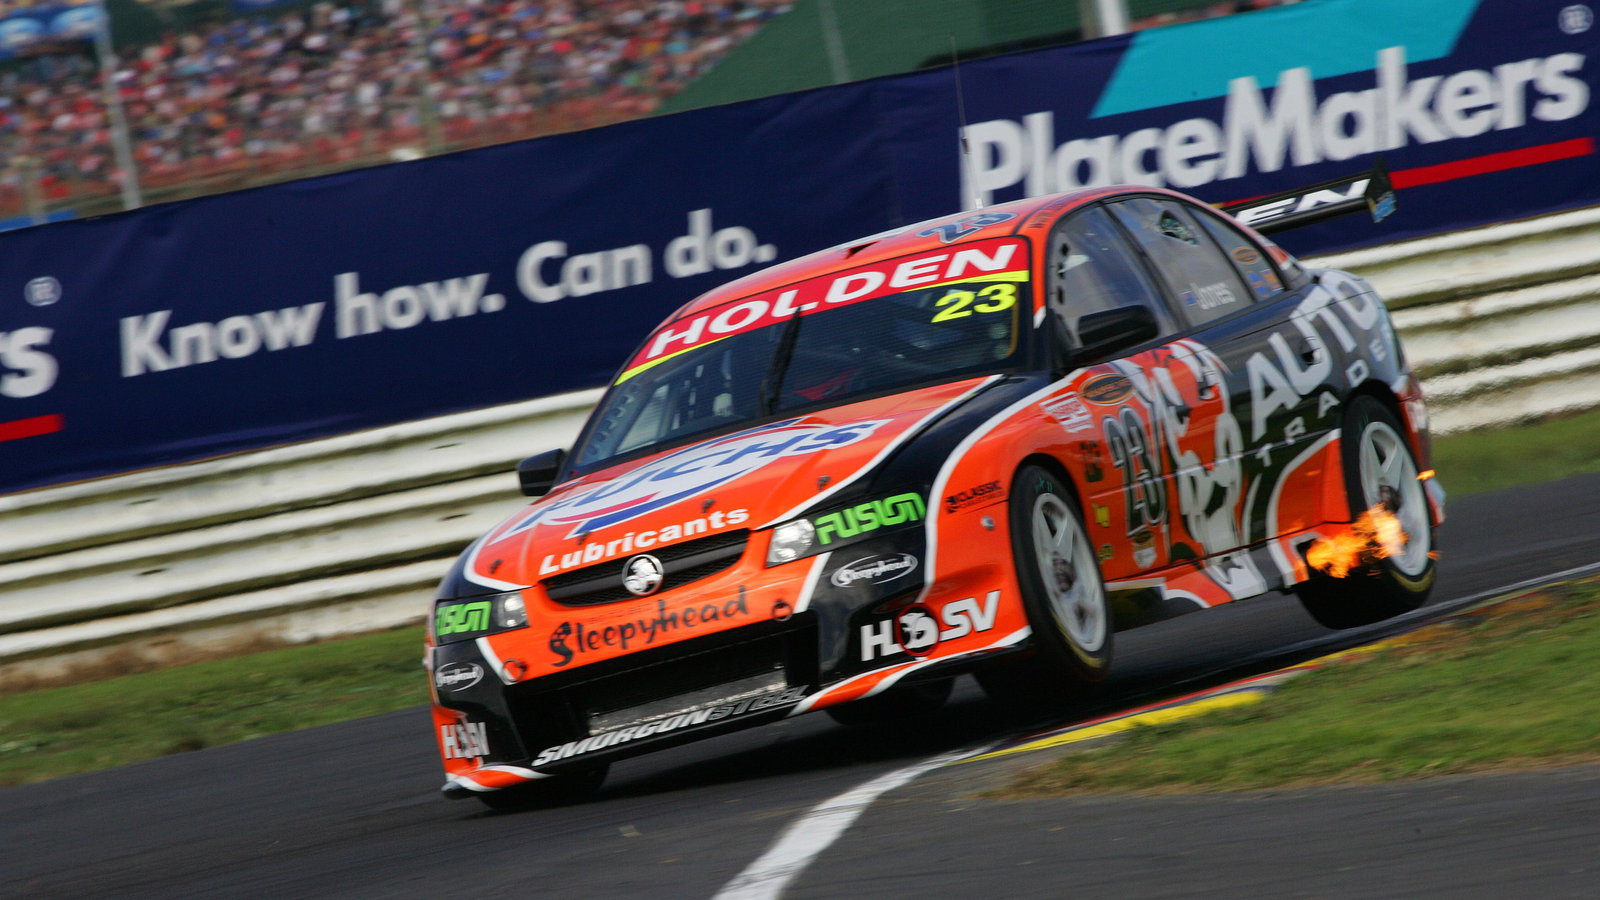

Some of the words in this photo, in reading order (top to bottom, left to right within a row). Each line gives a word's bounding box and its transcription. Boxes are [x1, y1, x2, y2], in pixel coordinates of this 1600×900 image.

[959, 46, 1590, 210] PlaceMakers
[119, 302, 326, 378] Know
[334, 272, 505, 340] how.
[517, 239, 653, 304] Can
[663, 206, 777, 278] do.
[646, 245, 1018, 360] HOLDEN
[931, 283, 1017, 323] 23
[0, 326, 59, 399] s
[1246, 271, 1380, 444] AUTO
[508, 419, 878, 536] FUCHS
[814, 492, 927, 545] FUSION
[1103, 405, 1169, 539] 23
[538, 508, 750, 576] Lubricants
[549, 585, 749, 668] Sleepyhead
